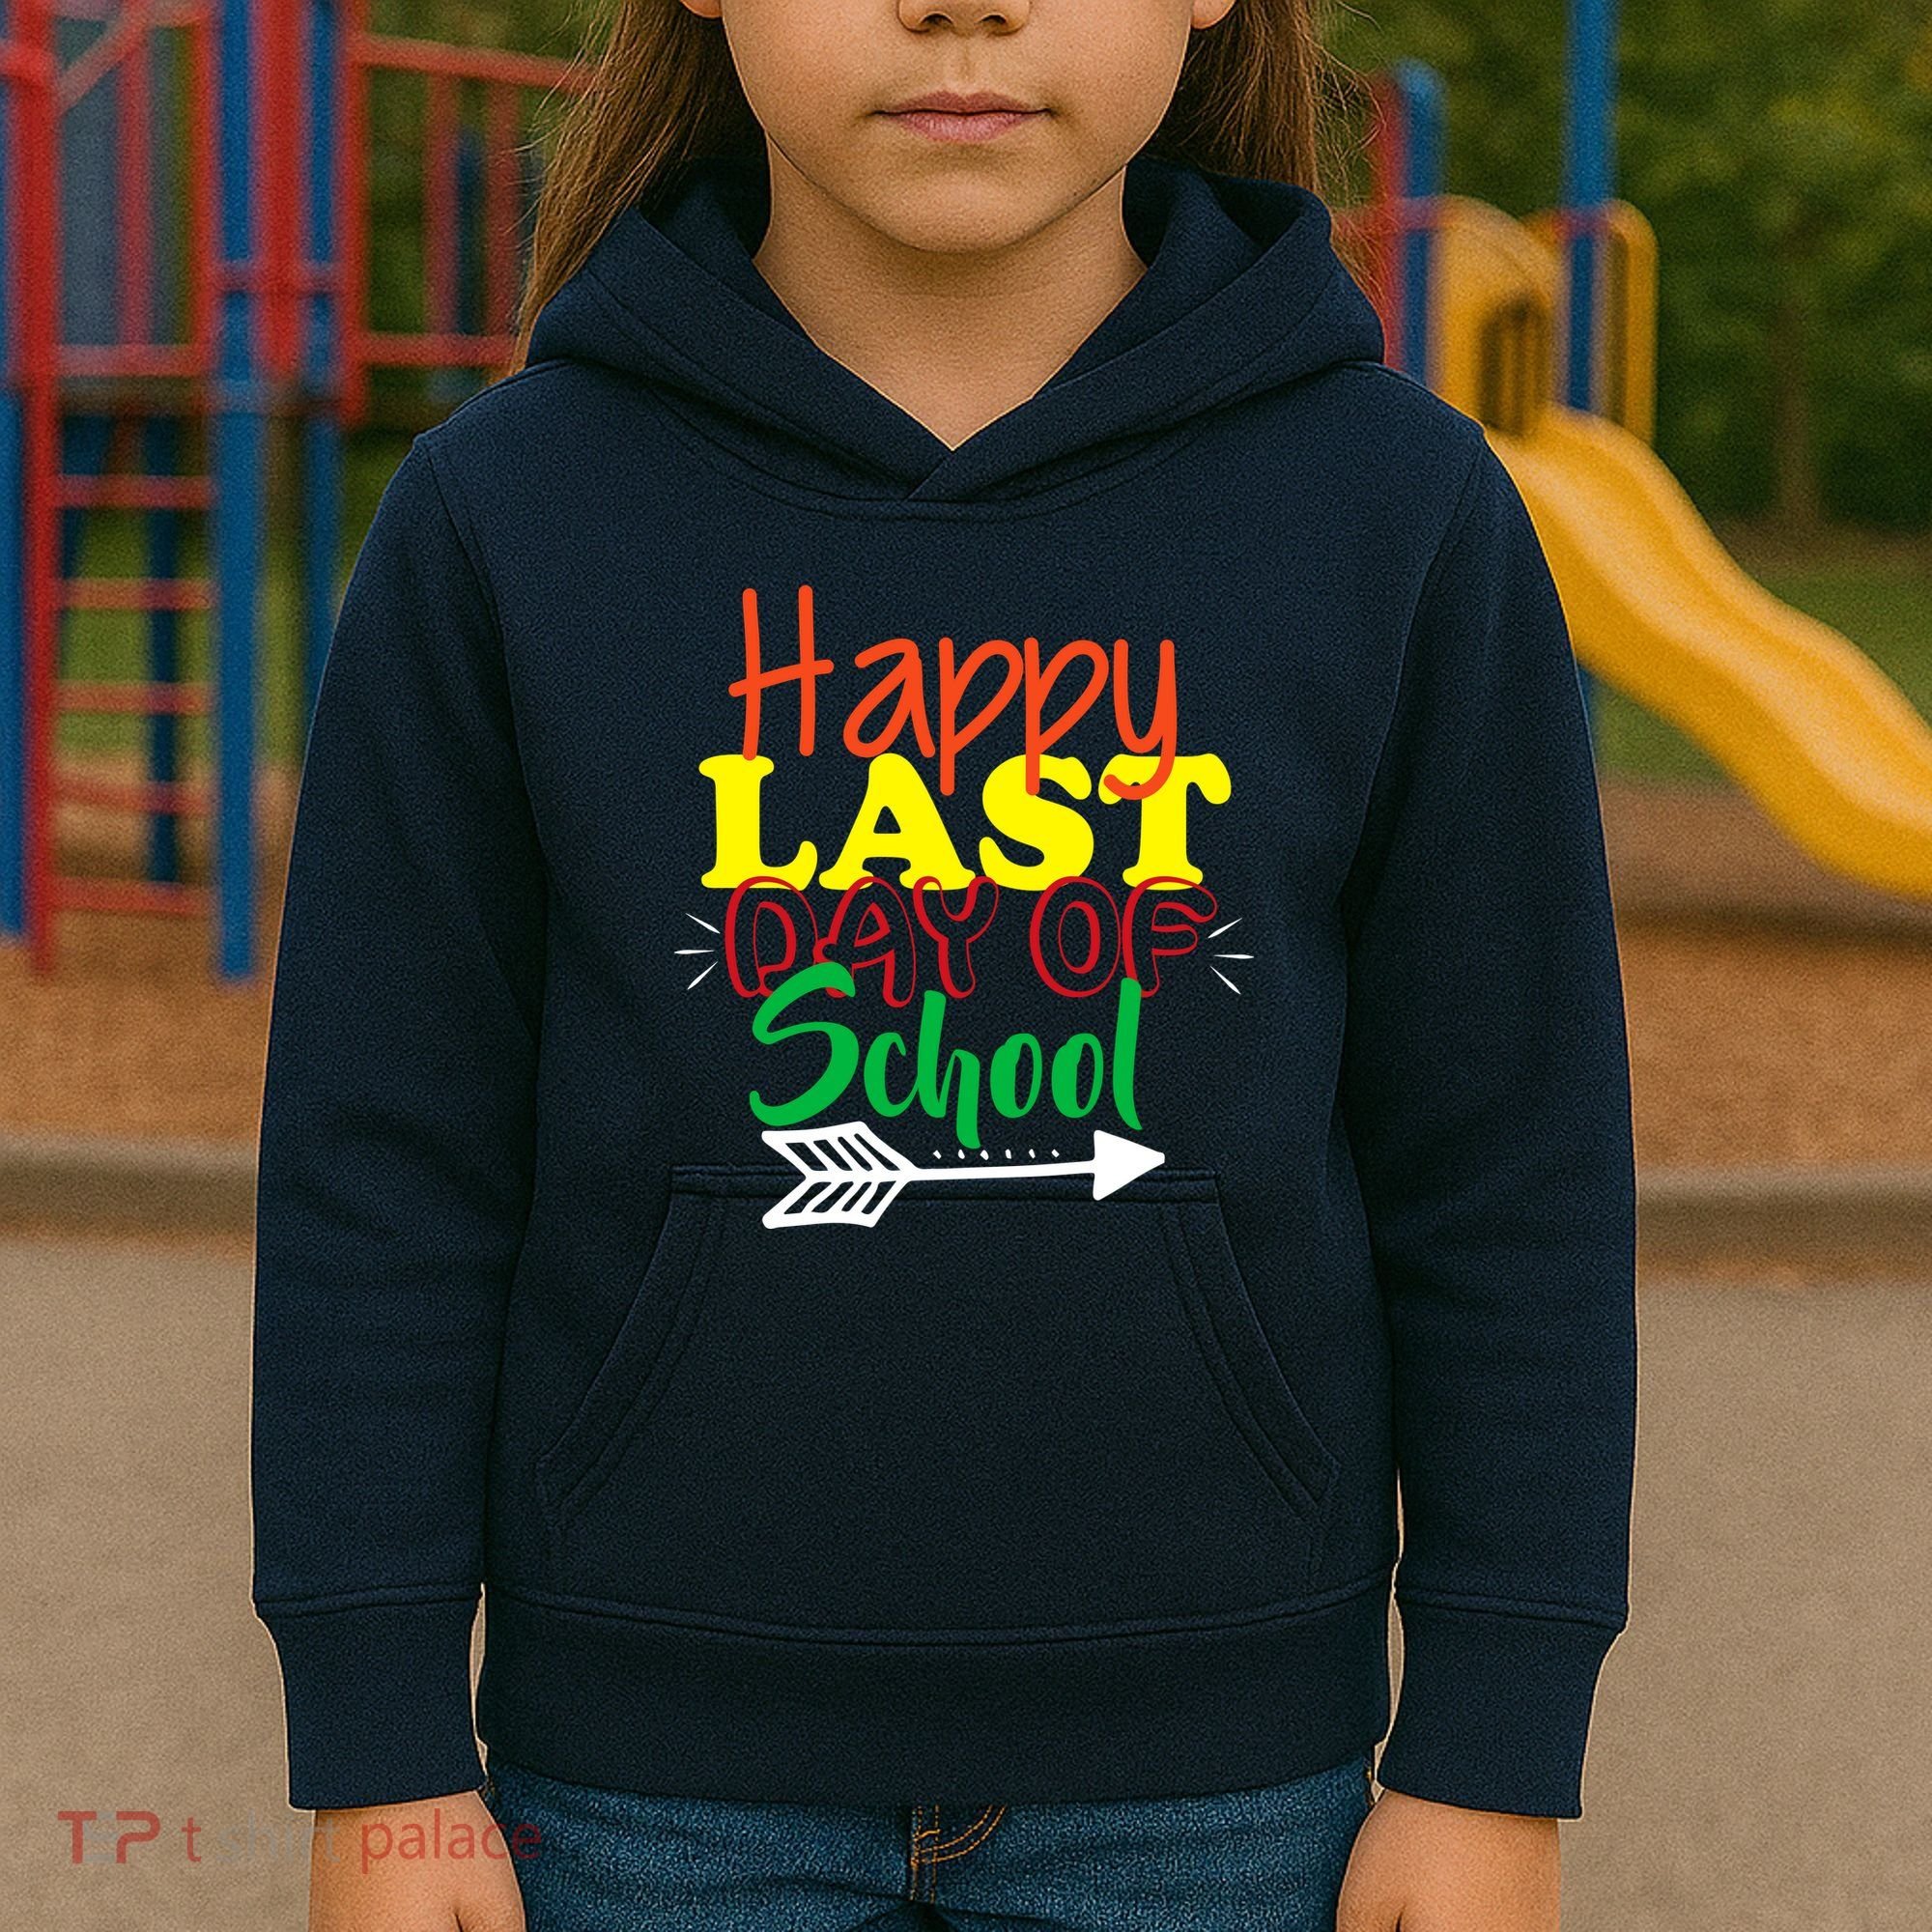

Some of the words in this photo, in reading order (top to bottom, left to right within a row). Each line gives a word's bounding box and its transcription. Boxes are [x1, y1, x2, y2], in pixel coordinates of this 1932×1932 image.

[728, 585, 1178, 800] Happy
[699, 753, 1232, 891] LAST
[724, 876, 999, 1008] DAY
[1030, 876, 1217, 999] OF
[750, 962, 1142, 1149] School
